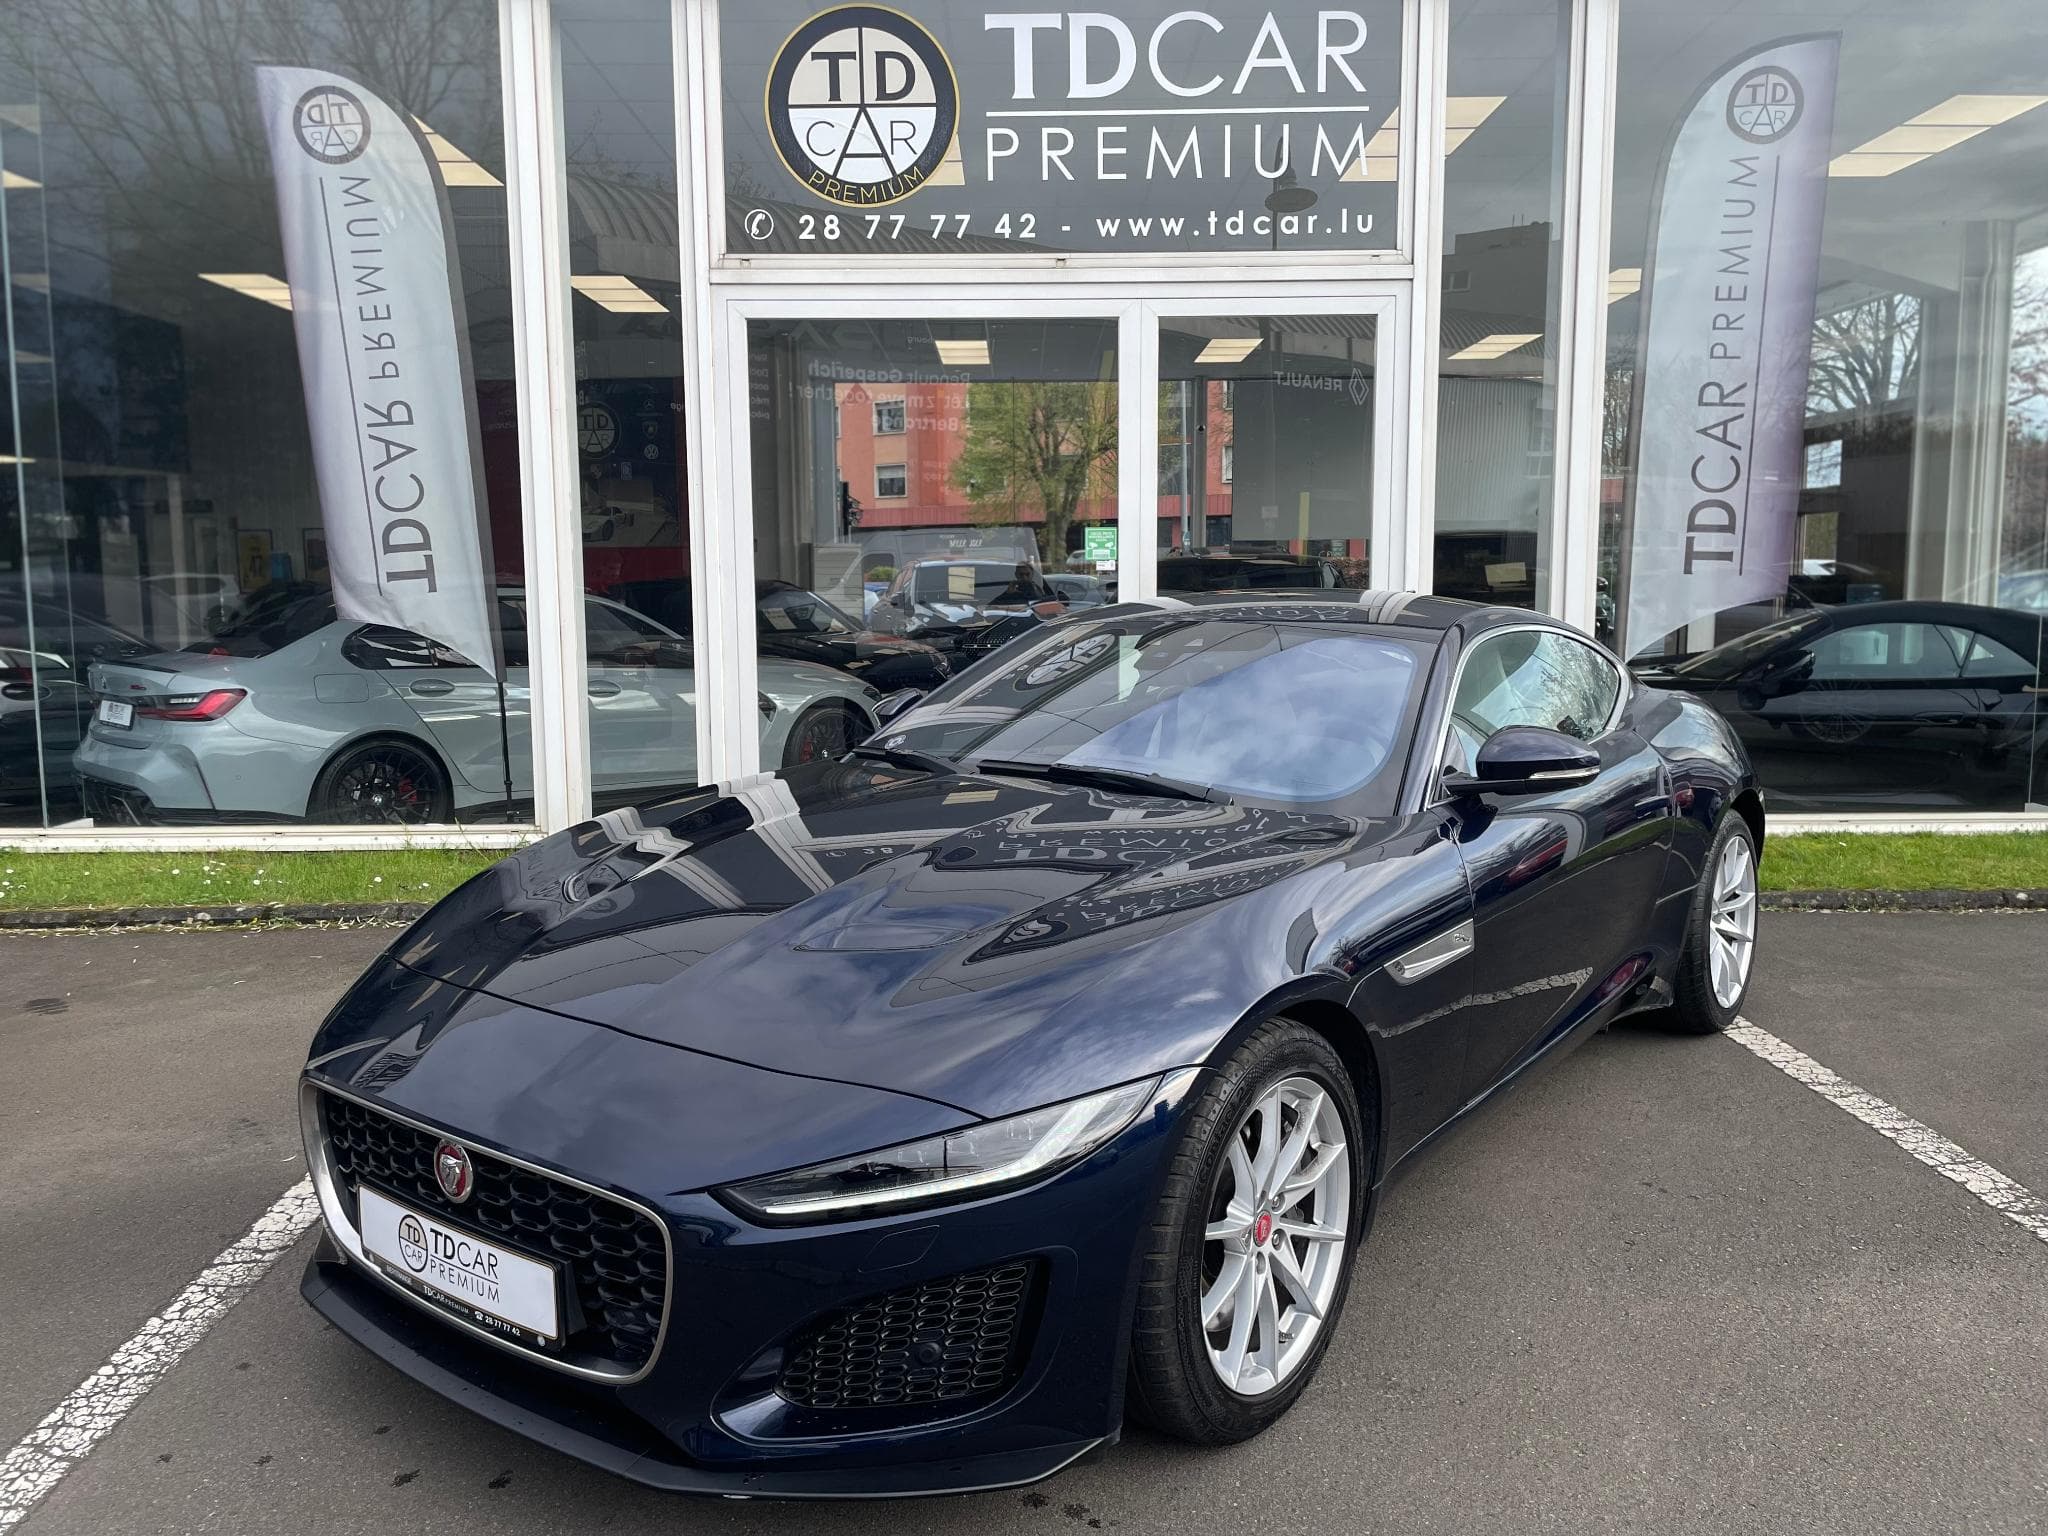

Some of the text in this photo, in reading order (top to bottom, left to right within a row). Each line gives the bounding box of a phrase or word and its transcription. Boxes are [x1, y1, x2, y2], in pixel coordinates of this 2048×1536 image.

[811, 51, 916, 102] TD
[984, 9, 1368, 100] TDCAR
[987, 123, 1369, 181] PREMIUM
[808, 165, 925, 204] PREMIUM
[798, 214, 841, 240] 28
[865, 213, 907, 239] 77
[931, 213, 972, 239] 77
[995, 213, 1037, 239] 42
[1097, 208, 1375, 238] www.tdcar.lu
[1709, 155, 1760, 360] PREMIUM
[1683, 381, 1748, 576] TDCAR
[404, 1244, 423, 1265] CAR
[405, 1223, 420, 1244] TD
[429, 1228, 499, 1280] TDCAR
[430, 1259, 500, 1304] PREMIUM
